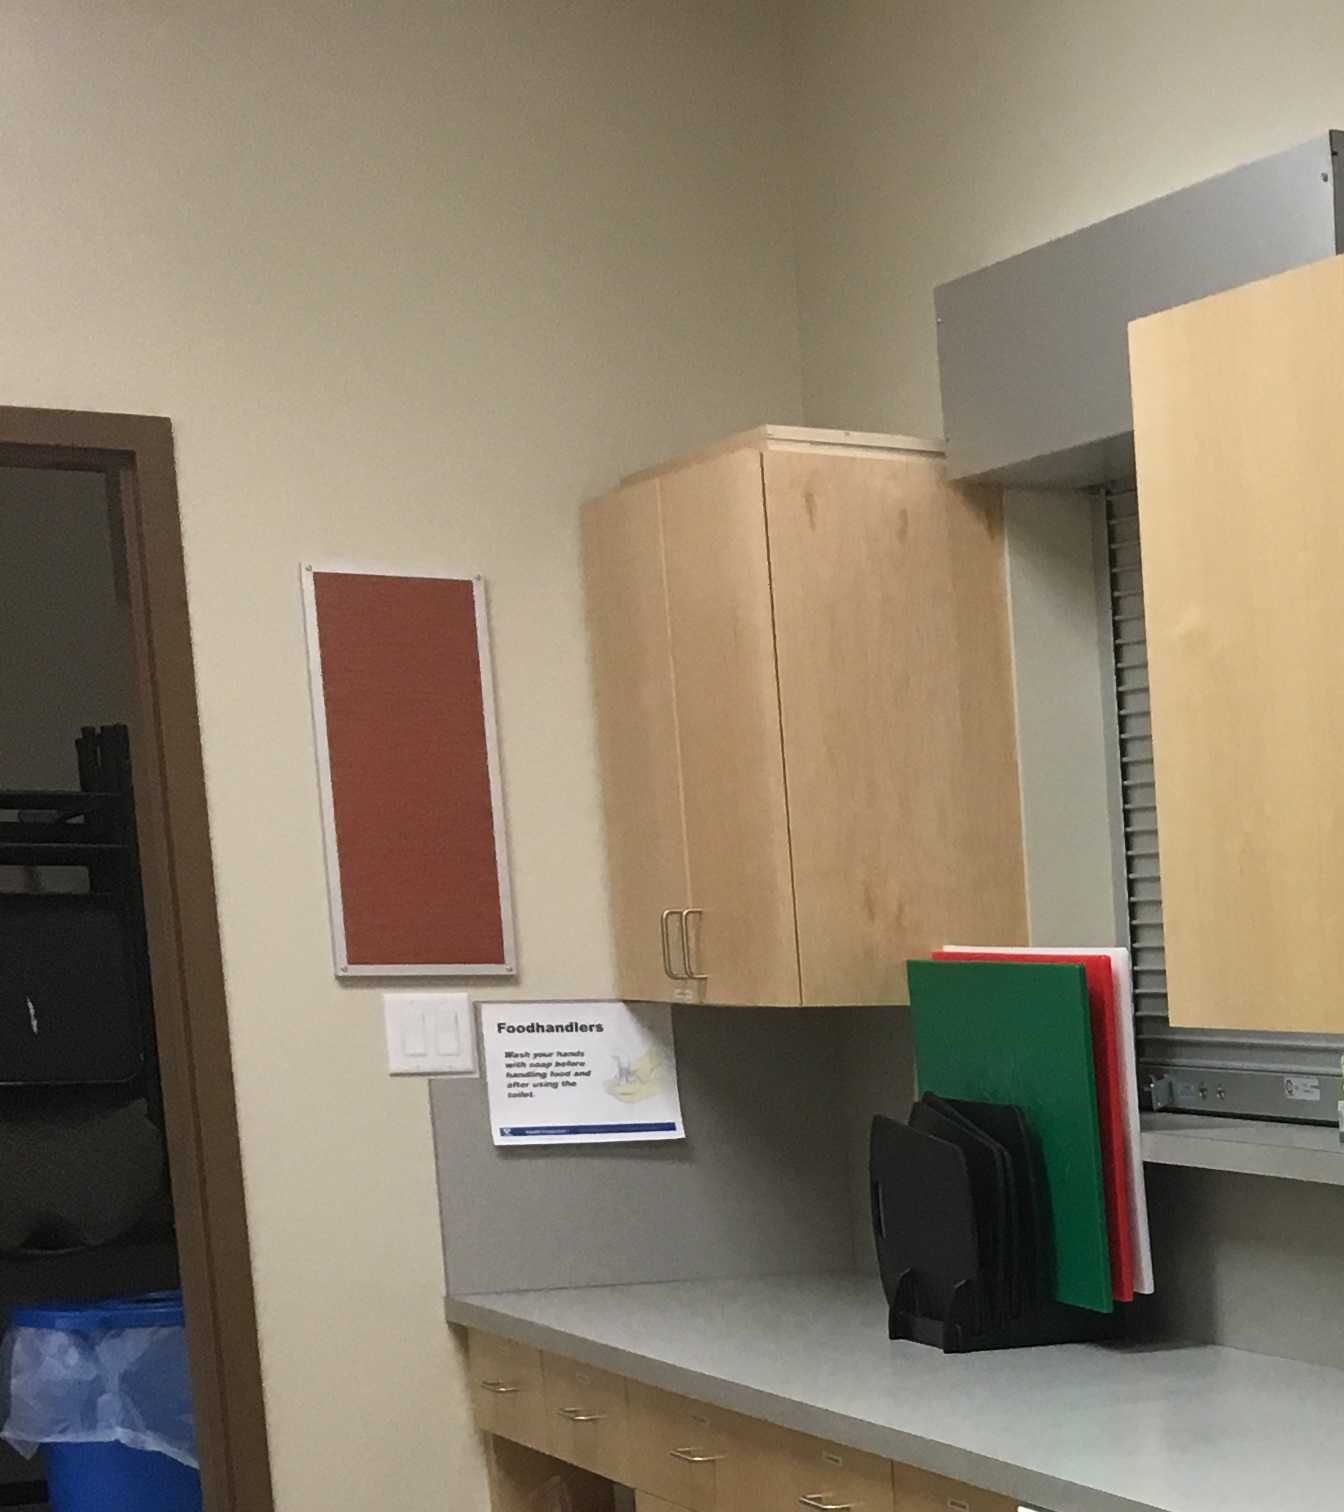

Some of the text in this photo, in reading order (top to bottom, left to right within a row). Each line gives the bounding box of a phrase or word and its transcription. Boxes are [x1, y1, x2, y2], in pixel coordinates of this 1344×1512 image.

[497, 1022, 604, 1034] Foodhandlers
[532, 1051, 554, 1060] your
[555, 1050, 585, 1058] hands
[506, 1071, 547, 1080] handling
[573, 1069, 592, 1077] and
[531, 1081, 559, 1090] using
